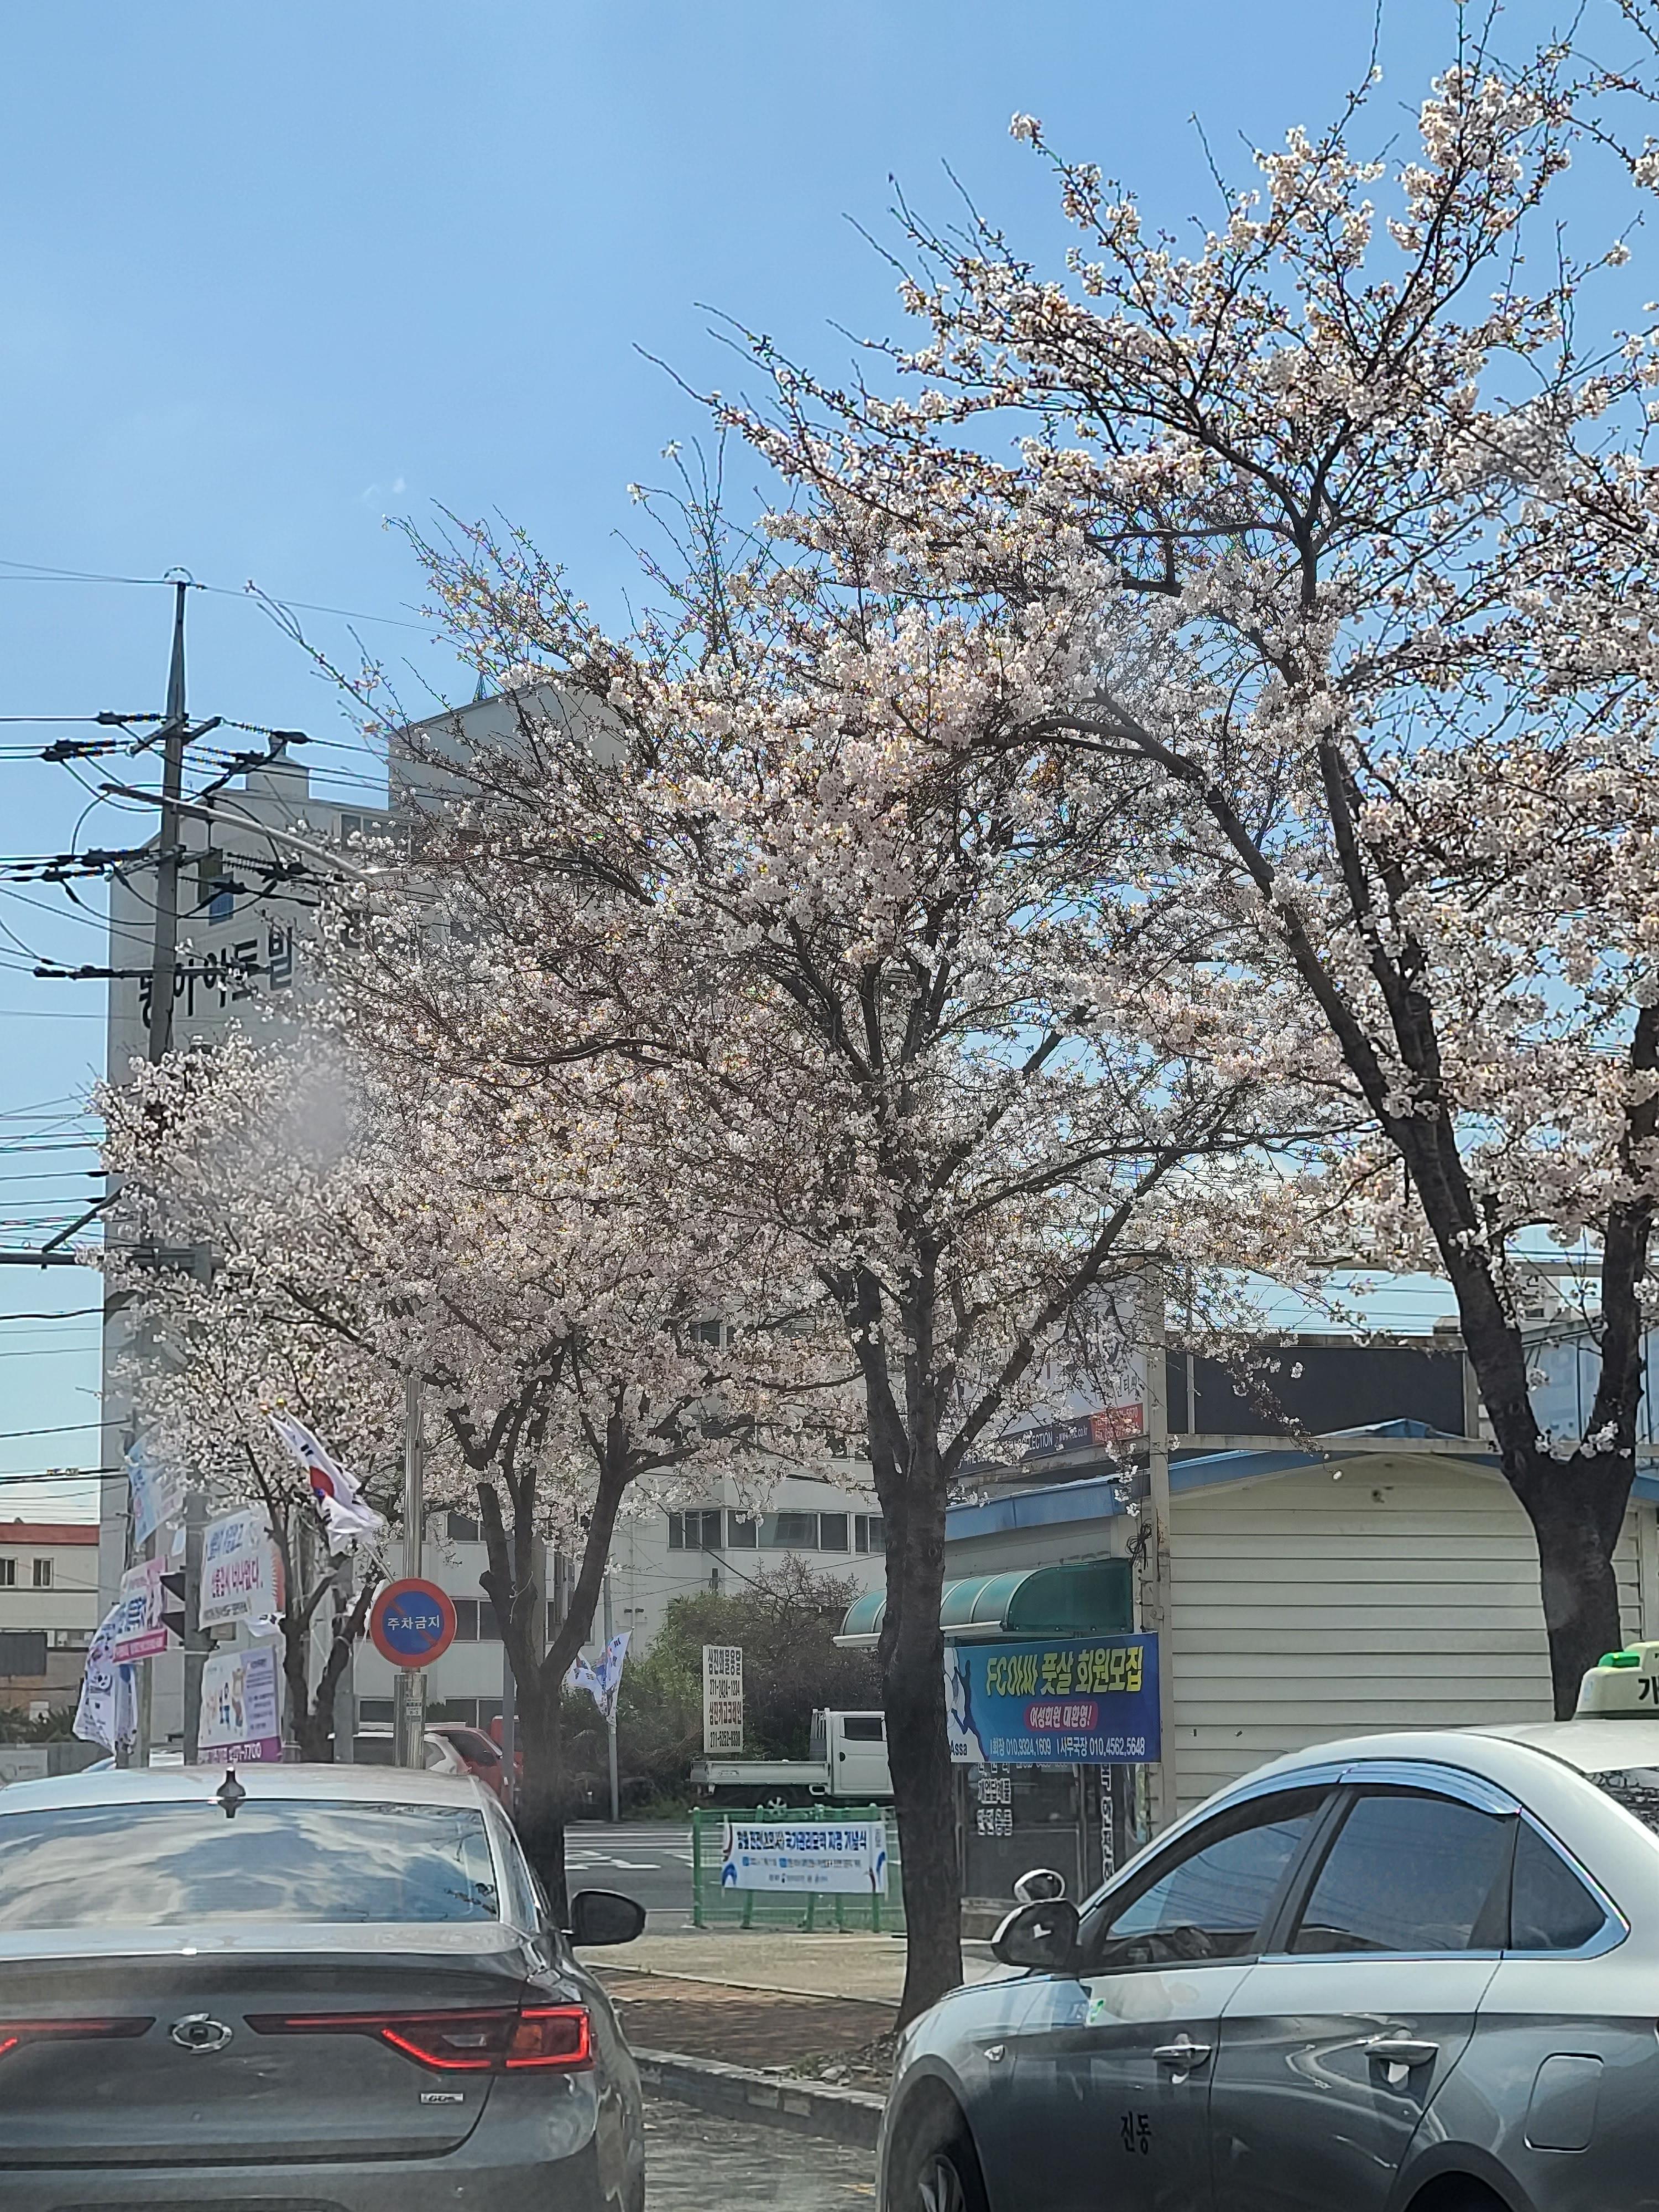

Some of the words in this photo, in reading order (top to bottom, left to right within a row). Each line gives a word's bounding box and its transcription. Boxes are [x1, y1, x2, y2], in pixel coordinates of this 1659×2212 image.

[387, 1615, 440, 1631] 주차금지
[708, 1648, 741, 1676] 삼진화물용달
[987, 1654, 1038, 1696] FC아싸
[1040, 1651, 1074, 1695] 풋살
[1075, 1646, 1144, 1693] 회원모집
[709, 1679, 740, 1698] 271-2424-1234
[709, 1701, 742, 1725] 삼진카고크레인
[1030, 1706, 1060, 1729] 여성회원
[1063, 1705, 1093, 1728] 대환영!
[950, 1741, 967, 1756] Assa
[1060, 1736, 1088, 1757] 사무국장
[1120, 2111, 1152, 2155] 진동
